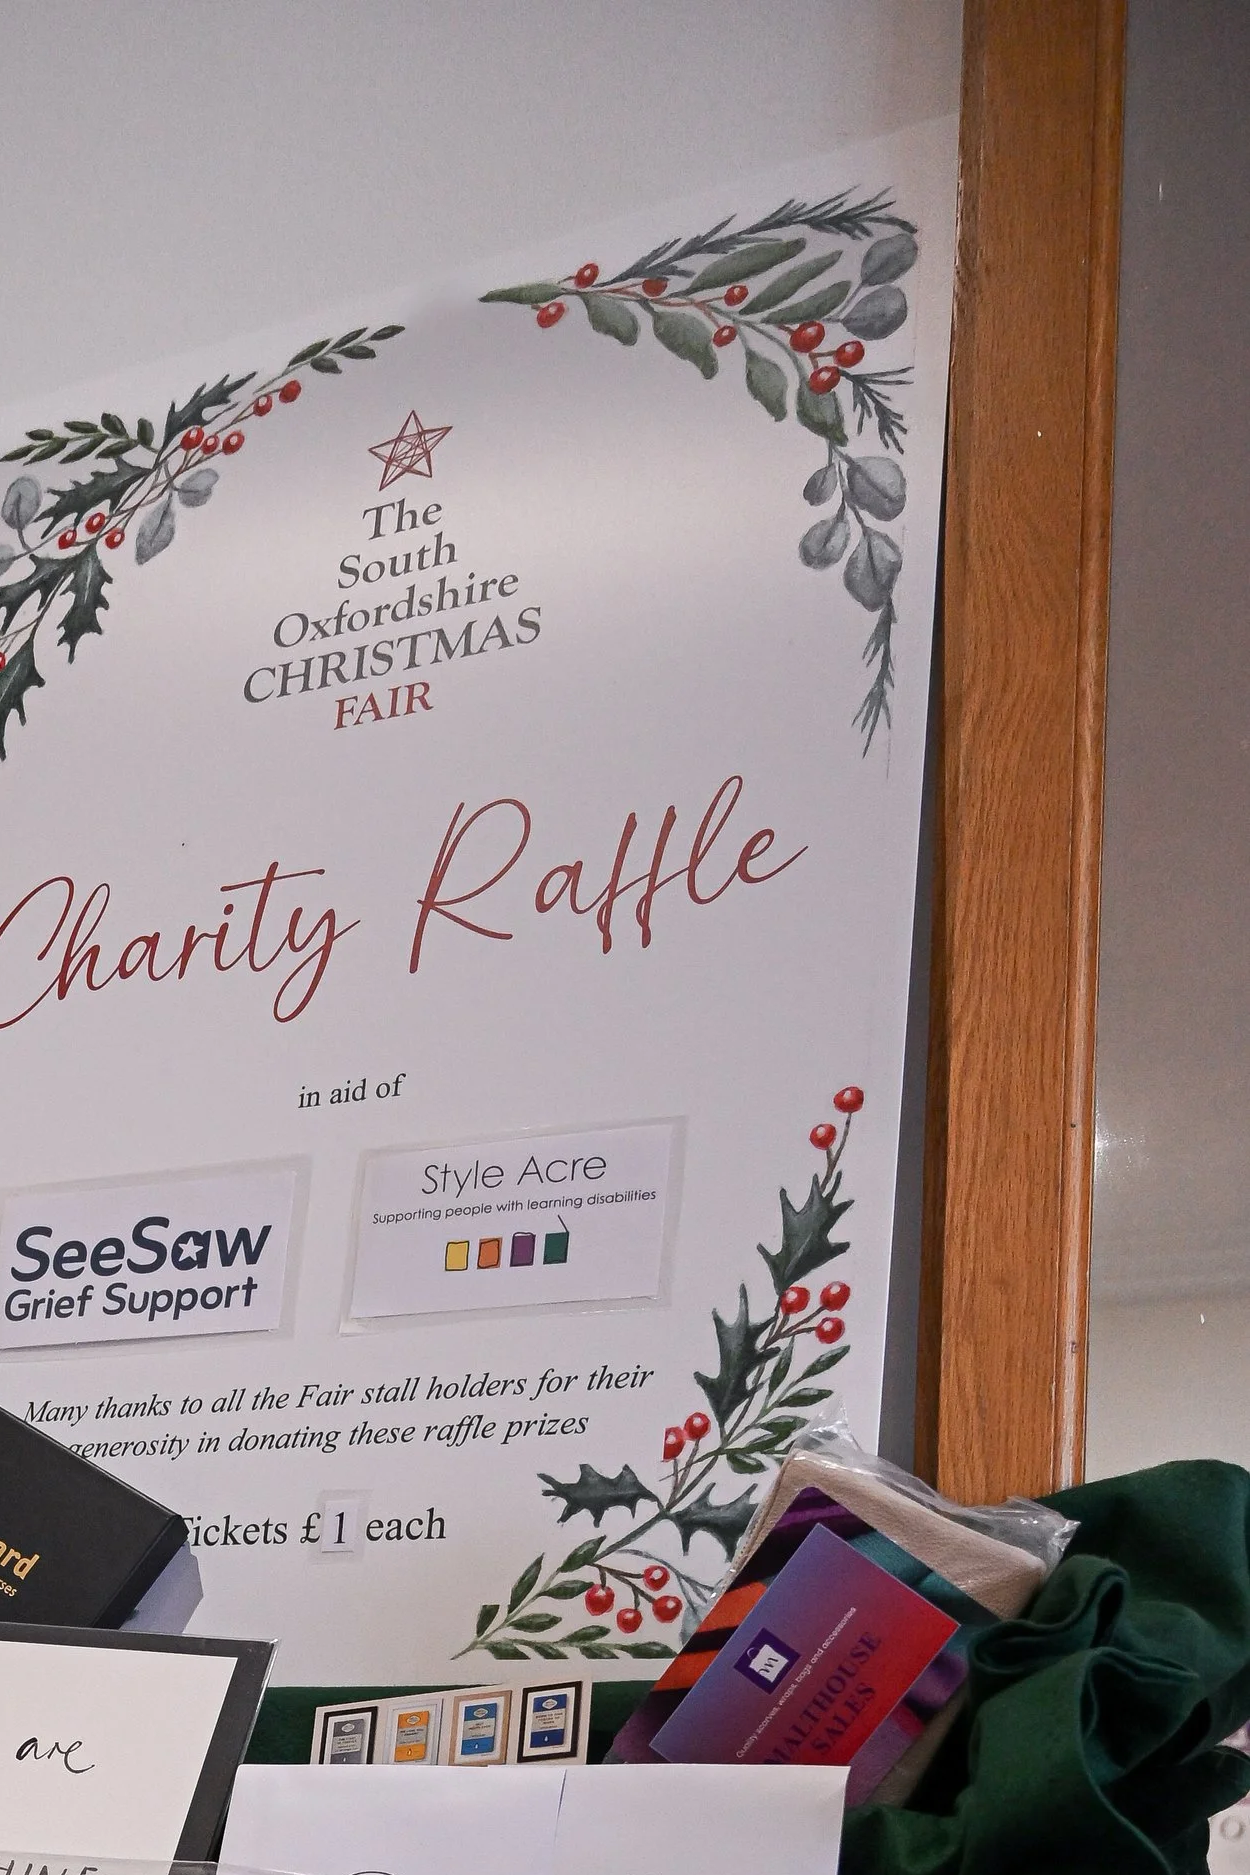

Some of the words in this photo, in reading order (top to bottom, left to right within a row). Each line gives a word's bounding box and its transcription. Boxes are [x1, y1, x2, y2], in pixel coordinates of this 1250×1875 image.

[363, 498, 443, 541] The
[338, 531, 457, 588] South
[274, 571, 520, 648] Oxfordshire
[243, 606, 543, 703] CHRISTMAS
[333, 682, 434, 730] FAIR
[409, 775, 808, 973] Raffle
[298, 1085, 321, 1109] in
[330, 1079, 367, 1105] aid
[376, 1074, 407, 1098] of
[422, 1160, 503, 1198] Style
[517, 1155, 606, 1185] Acre
[372, 1209, 441, 1225] Supporting
[445, 1203, 492, 1219] people
[496, 1200, 523, 1212] with
[527, 1196, 582, 1210] learning
[587, 1189, 656, 1206] disabilities
[11, 1217, 272, 1282] SeeSaw
[5, 1285, 94, 1322] Grief
[102, 1277, 257, 1321] Support
[24, 1401, 89, 1427] Many
[95, 1394, 172, 1420] thanks
[180, 1396, 201, 1414] to
[211, 1389, 246, 1413] all
[252, 1387, 289, 1410] the
[296, 1383, 354, 1408] Fair
[361, 1377, 420, 1404] stall
[426, 1373, 527, 1400] holders
[530, 1368, 578, 1401] for
[587, 1365, 654, 1391] their
[197, 1432, 220, 1453] in
[229, 1426, 341, 1453] donating
[349, 1421, 416, 1446] these
[423, 1415, 496, 1447] raffle
[501, 1413, 589, 1444] prizes
[366, 1507, 446, 1541] each
[735, 1732, 758, 1759] Quality
[755, 1704, 780, 1735] scarves,
[794, 1662, 813, 1684] bags
[808, 1647, 824, 1664] and
[820, 1605, 856, 1649] accessories
[812, 1683, 876, 1753] SALES
[16, 1735, 95, 1773] are
